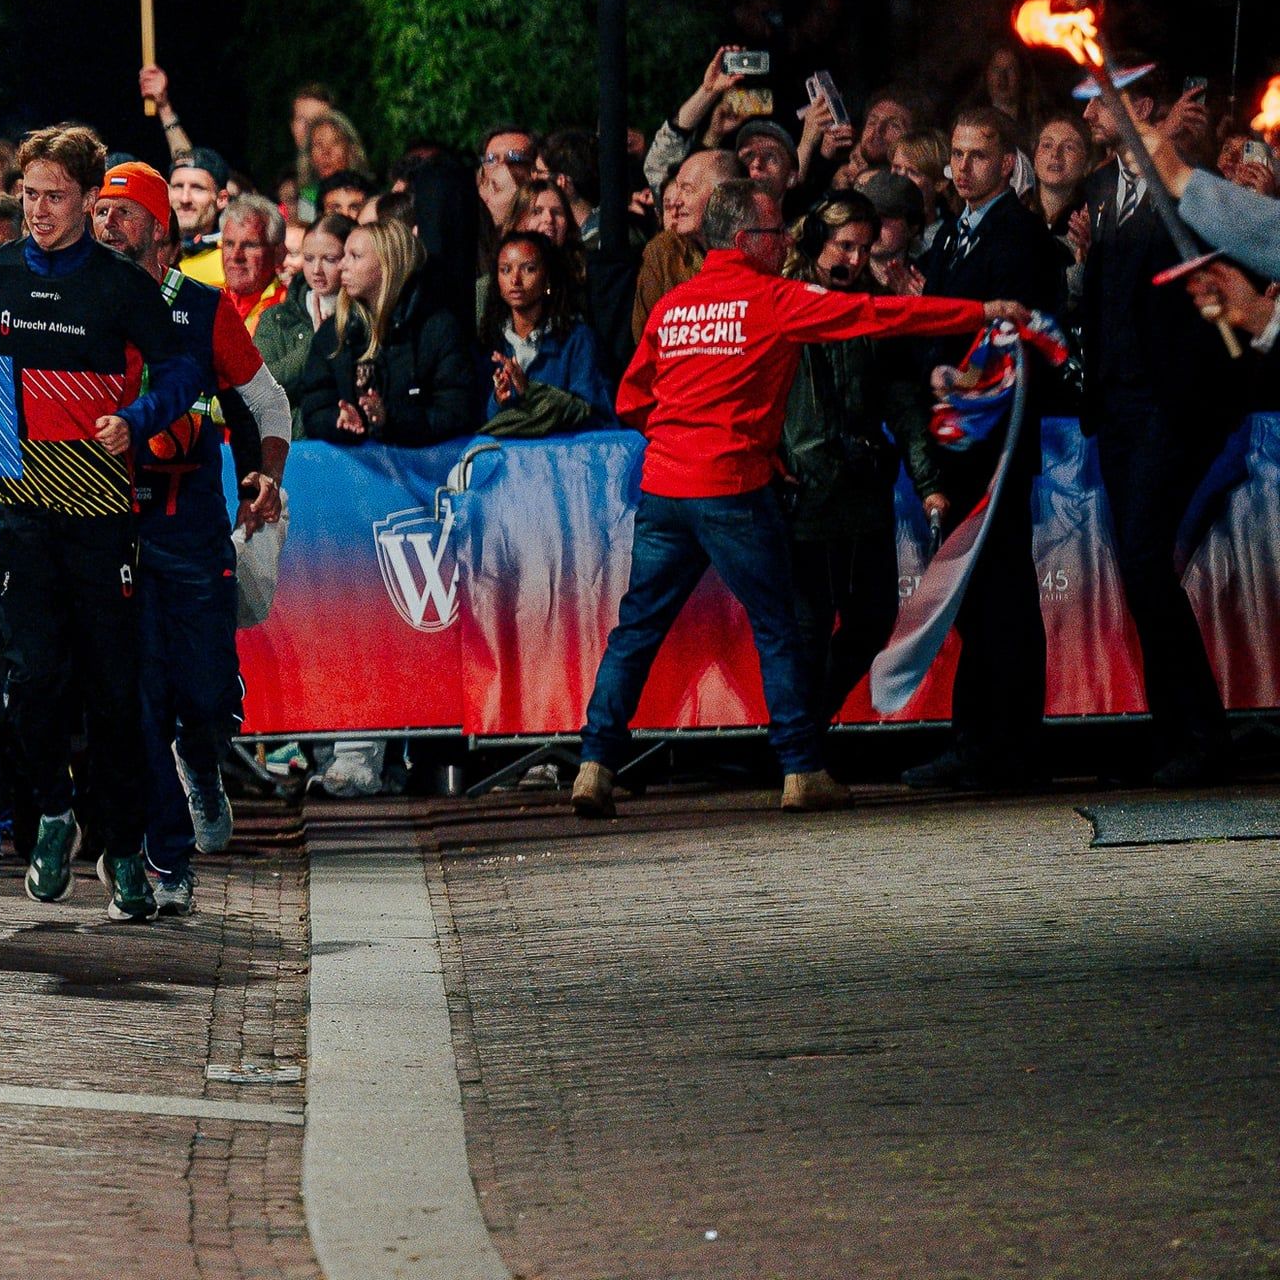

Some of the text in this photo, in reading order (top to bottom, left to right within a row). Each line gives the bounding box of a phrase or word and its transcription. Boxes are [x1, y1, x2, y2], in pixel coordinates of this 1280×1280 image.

[662, 300, 749, 324] #MAAKHET
[13, 318, 86, 336] Utrecht Atletiek
[657, 321, 747, 347] VERSCHIL
[1042, 570, 1069, 592] 45
